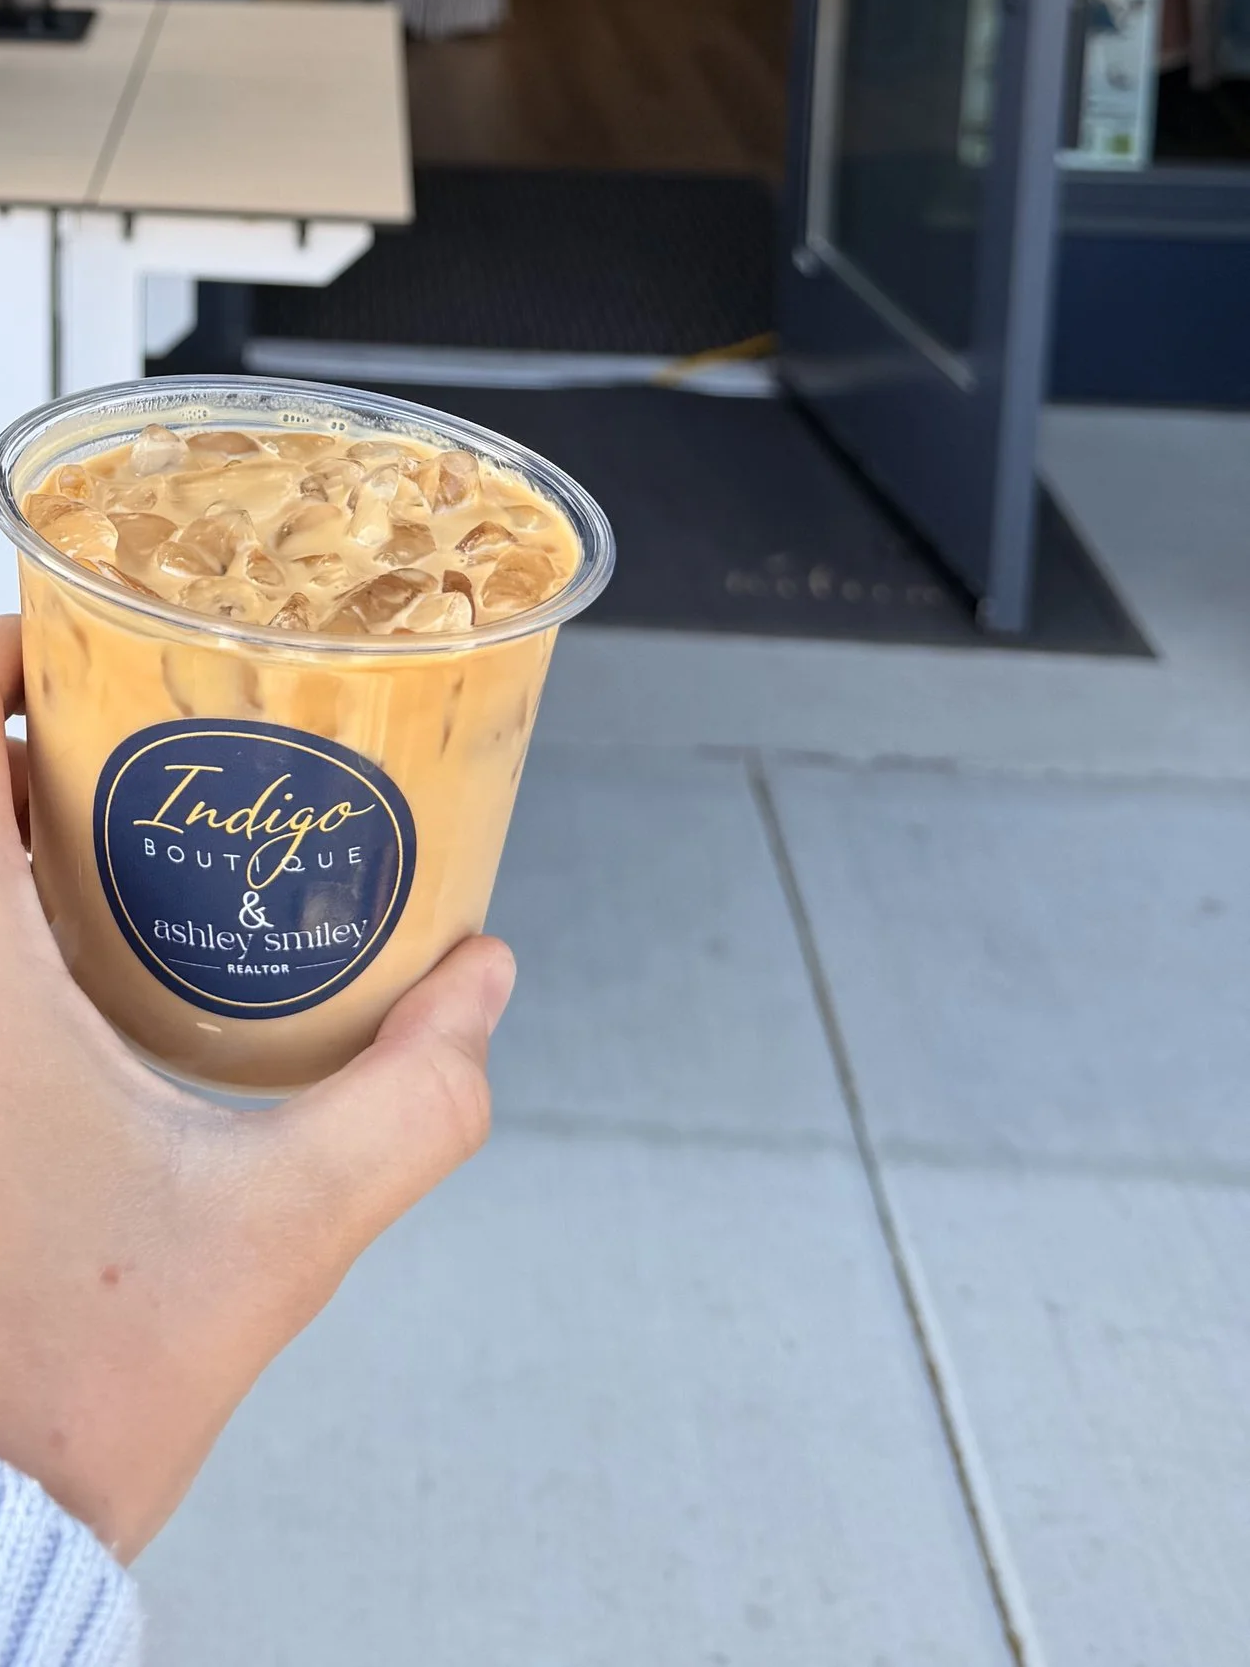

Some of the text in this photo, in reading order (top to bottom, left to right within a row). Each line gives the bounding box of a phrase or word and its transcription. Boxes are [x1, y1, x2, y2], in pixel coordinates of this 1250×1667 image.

[133, 764, 375, 889] Indigo
[143, 837, 363, 873] BOUTIQUE
[238, 890, 274, 928] &
[153, 918, 368, 960] ashley smiley
[227, 963, 290, 974] REALTOR
